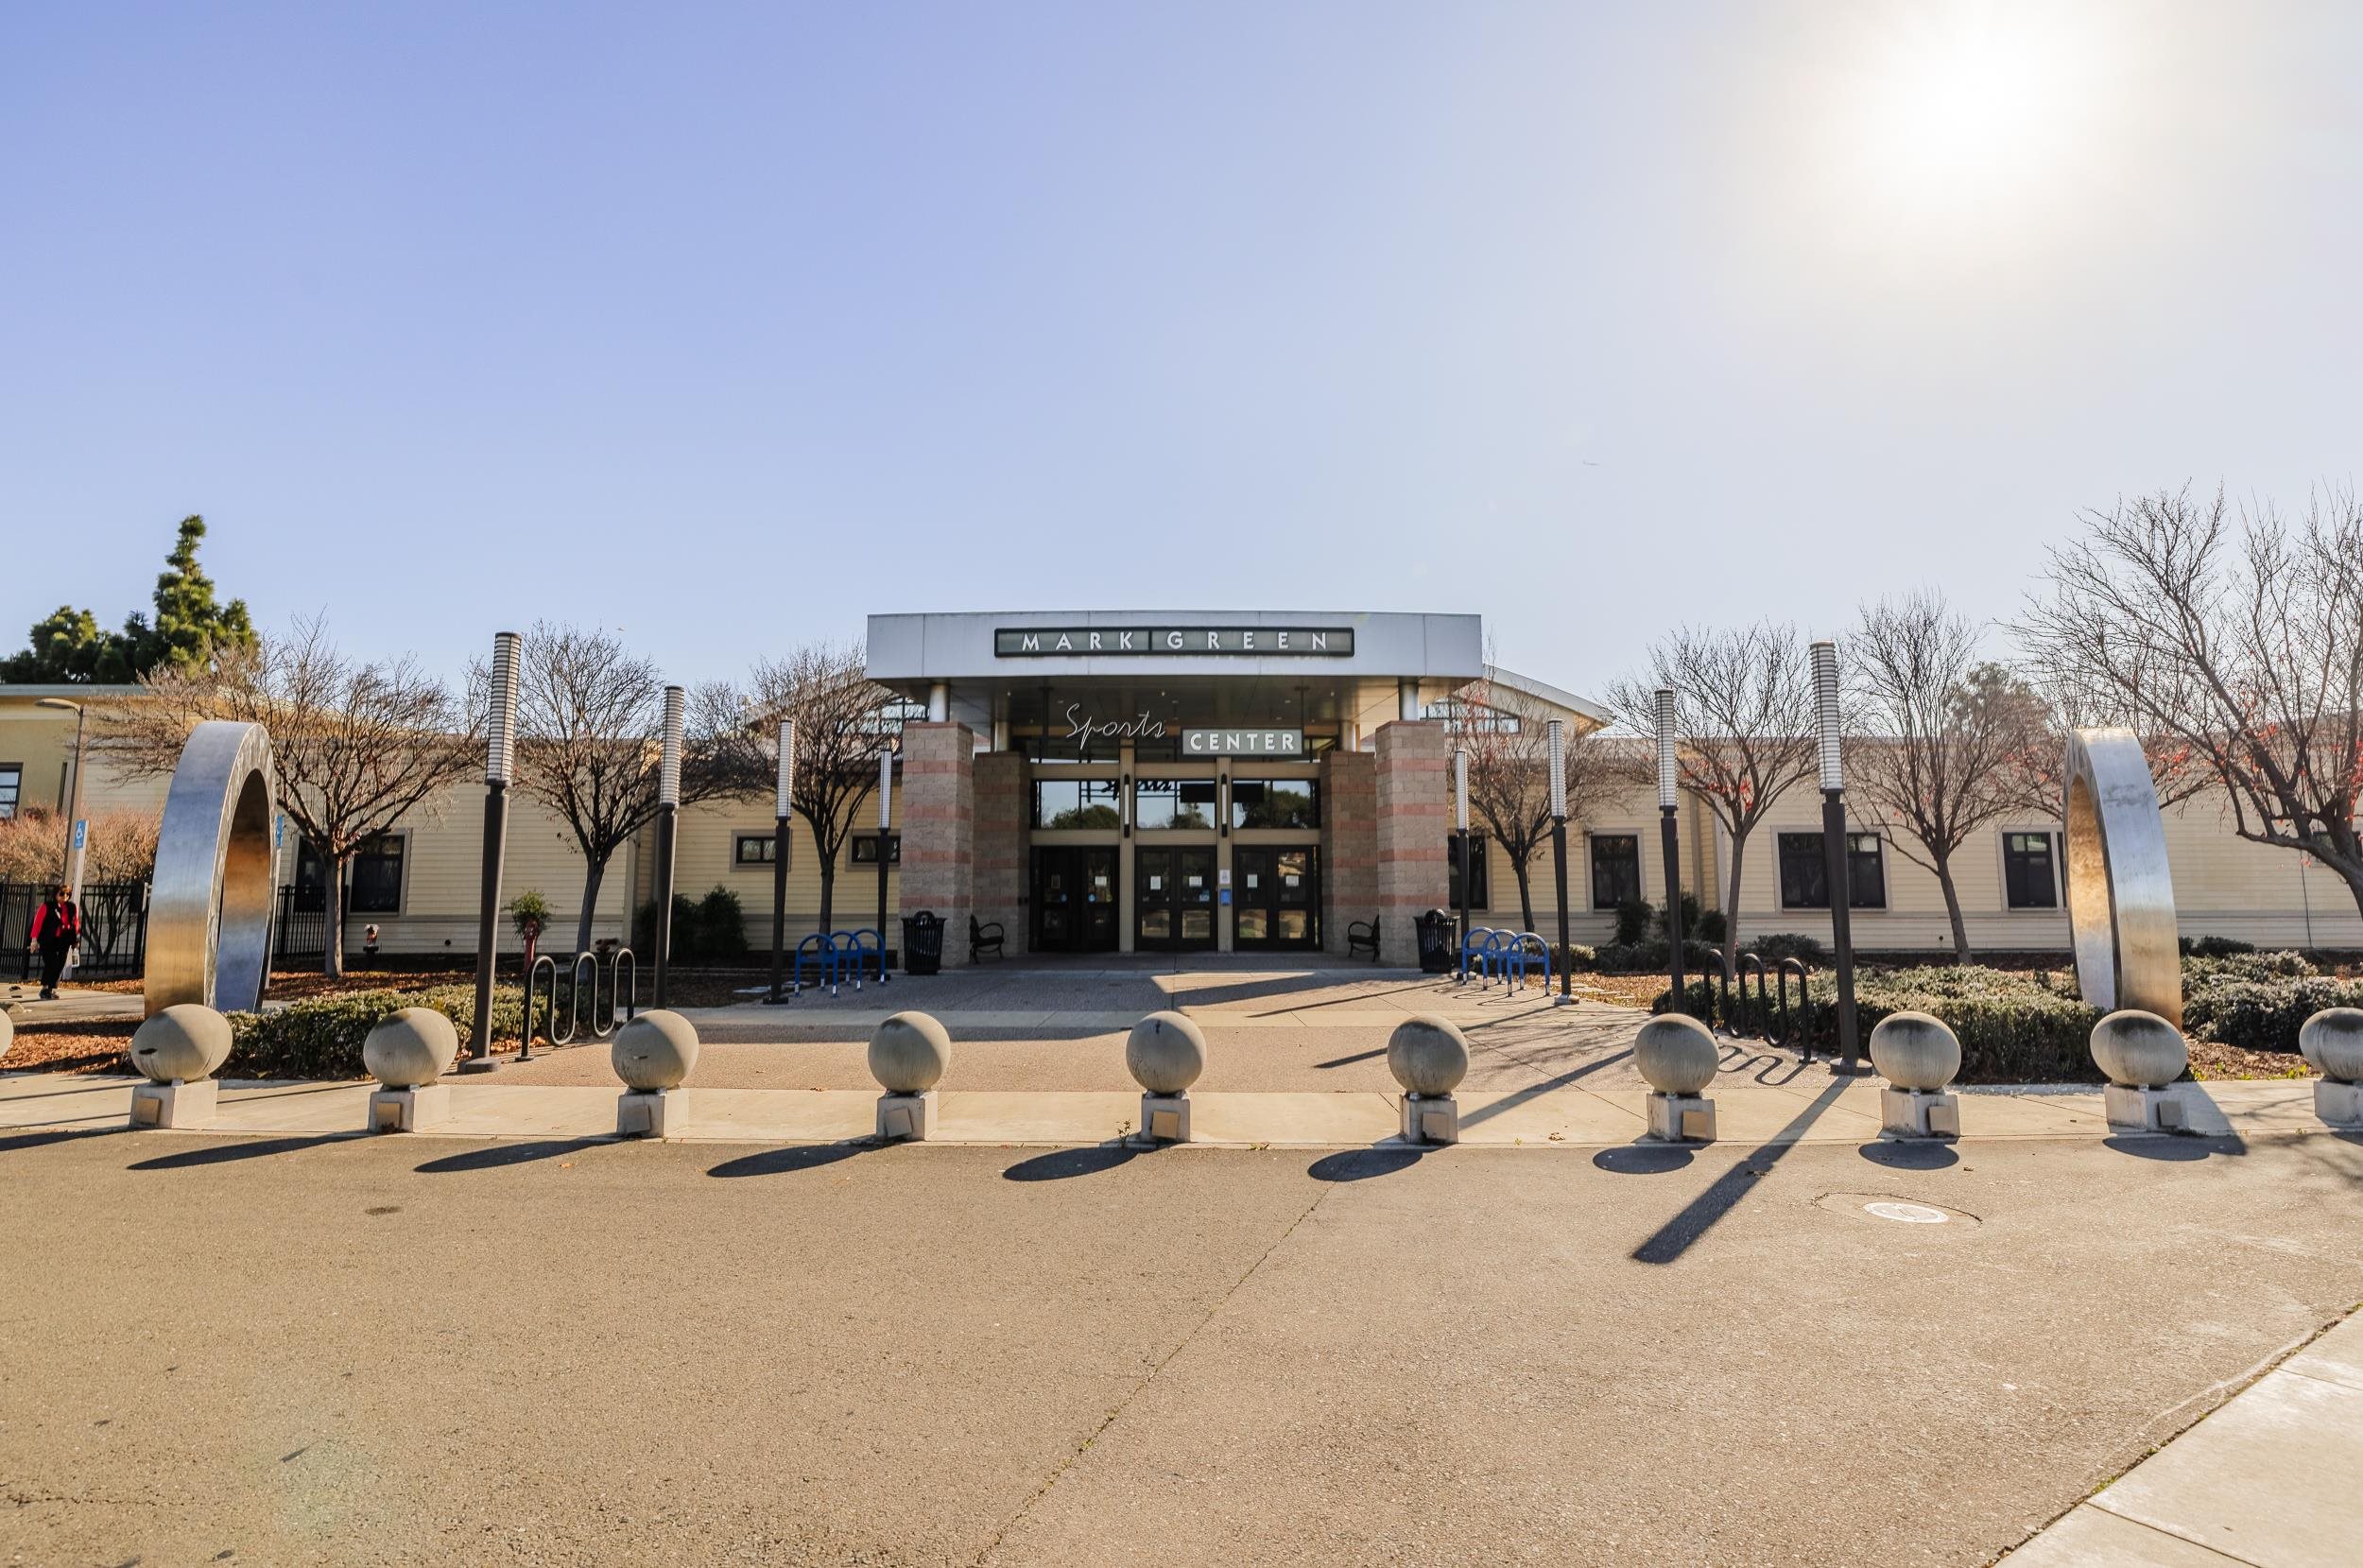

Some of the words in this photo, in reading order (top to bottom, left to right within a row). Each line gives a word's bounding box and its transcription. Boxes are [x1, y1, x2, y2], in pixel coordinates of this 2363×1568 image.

[1022, 632, 1132, 651] MARK
[1167, 631, 1326, 650] GREEN
[1066, 702, 1165, 750] Sports
[1190, 733, 1295, 751] CENTER
